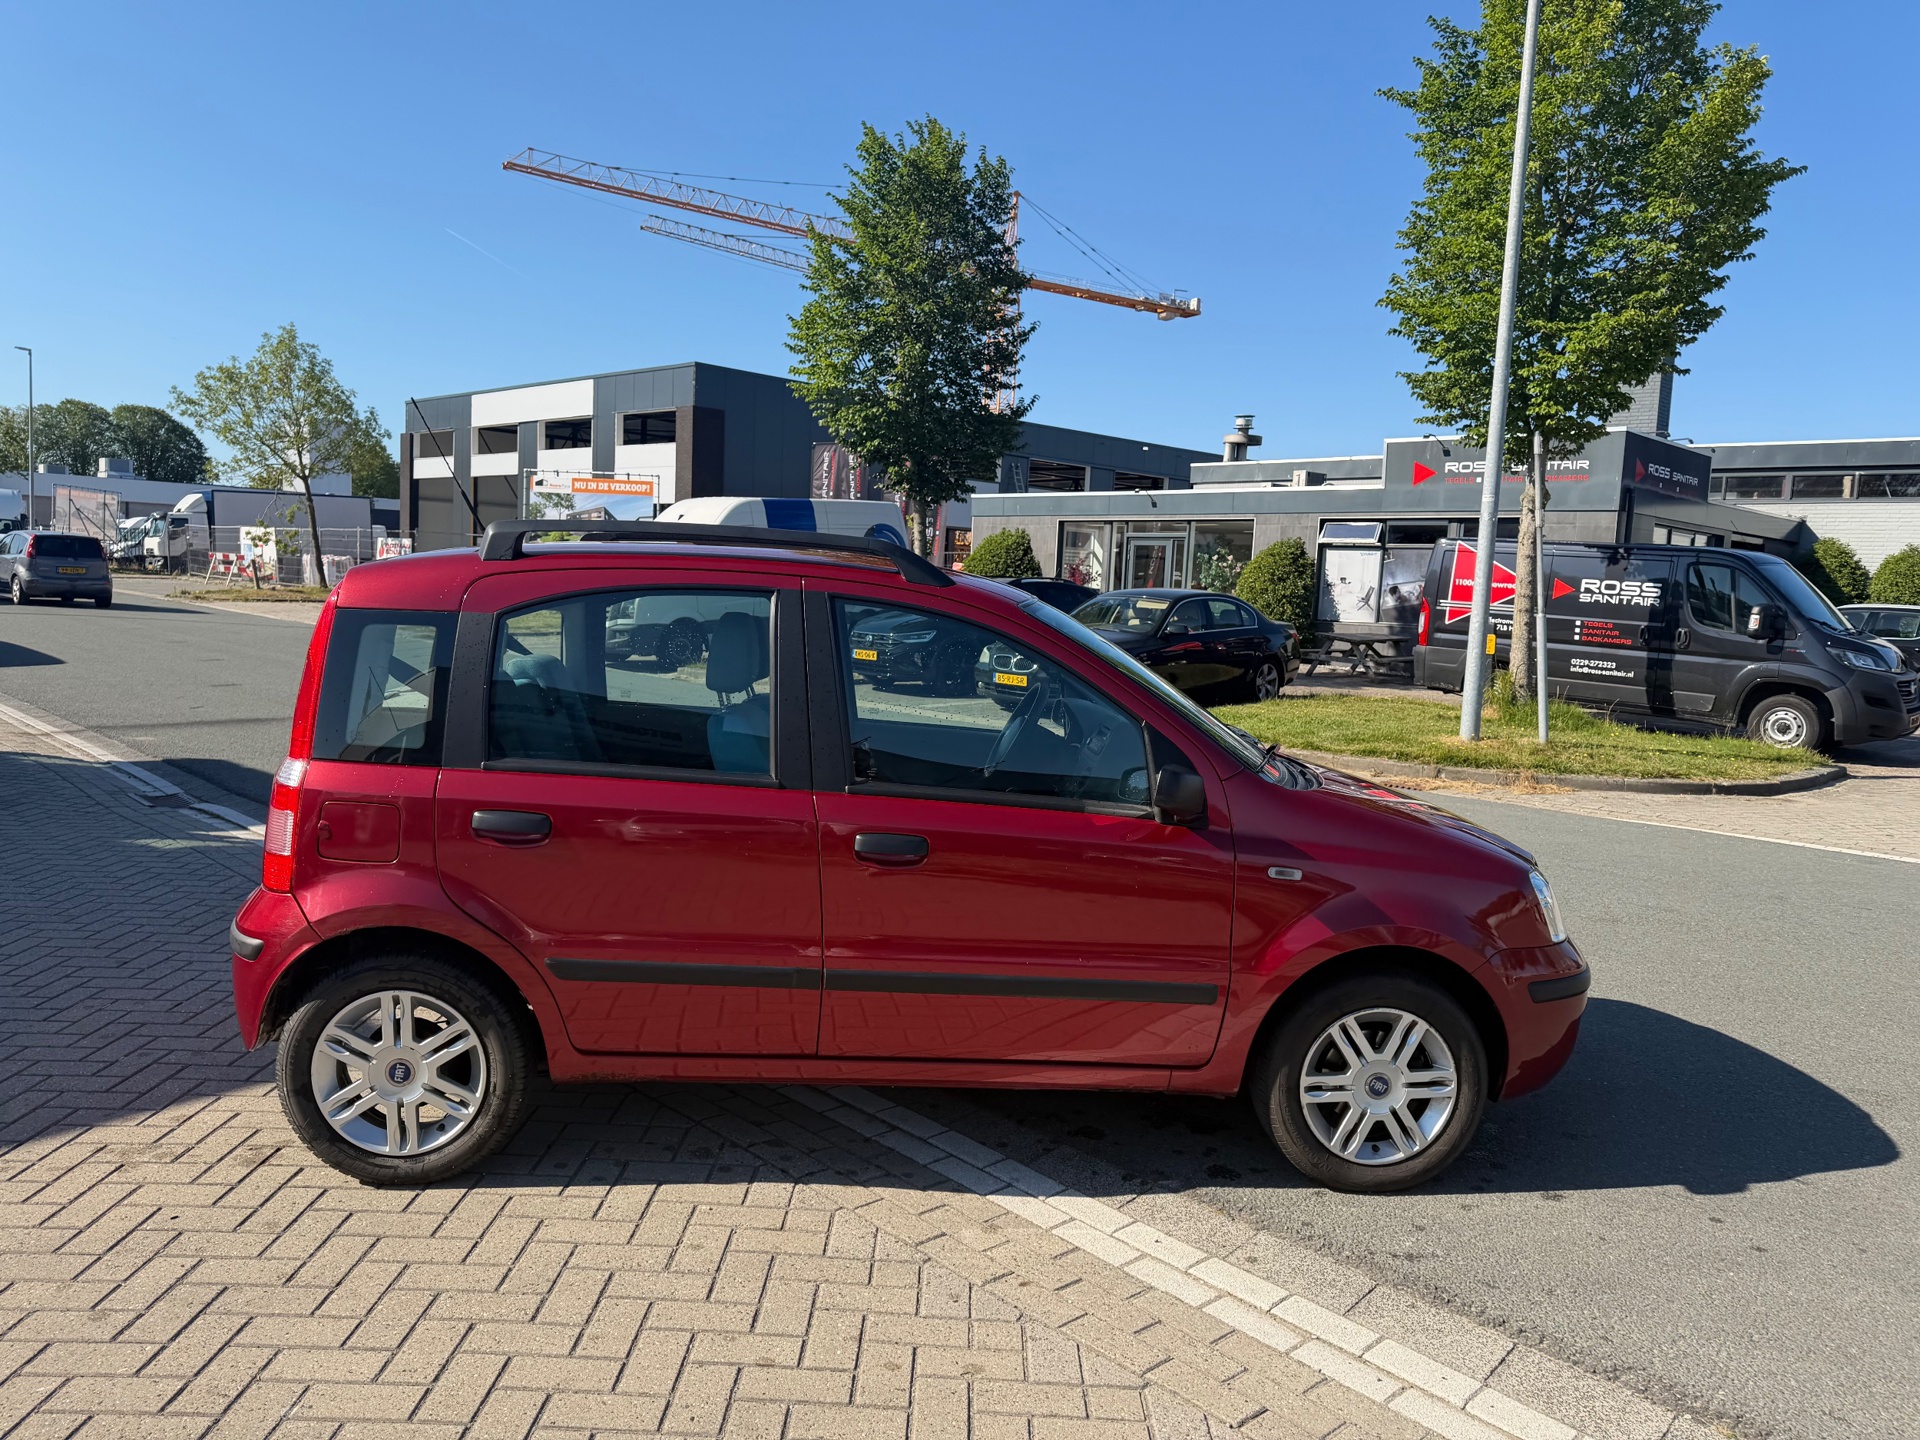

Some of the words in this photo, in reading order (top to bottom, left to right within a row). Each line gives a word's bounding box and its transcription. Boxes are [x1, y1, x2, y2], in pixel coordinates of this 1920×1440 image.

[1444, 461, 1487, 474] ROS
[1511, 459, 1590, 472] SITAIR
[821, 451, 830, 500] ANITAIR
[1445, 476, 1475, 484] TEGELS
[1545, 474, 1589, 482] DKAMERS
[1648, 463, 1671, 479] ROSS
[1672, 471, 1699, 487] SANITAIR
[574, 481, 585, 489] NU
[587, 482, 597, 490] IN
[598, 482, 609, 491] DE
[610, 482, 650, 493] VERKOOP!
[1455, 579, 1475, 587] 1100
[1580, 579, 1662, 597] ROSS
[1579, 593, 1660, 607] SANITAIR
[1582, 628, 1620, 636] SANITAIR
[1581, 635, 1632, 645] BADKAMERS
[1570, 658, 1616, 669] 0229-272323
[997, 674, 1025, 685] 85-RJ-SR
[394, 1063, 406, 1082] FIAT
[1370, 1079, 1388, 1093] FIAT
